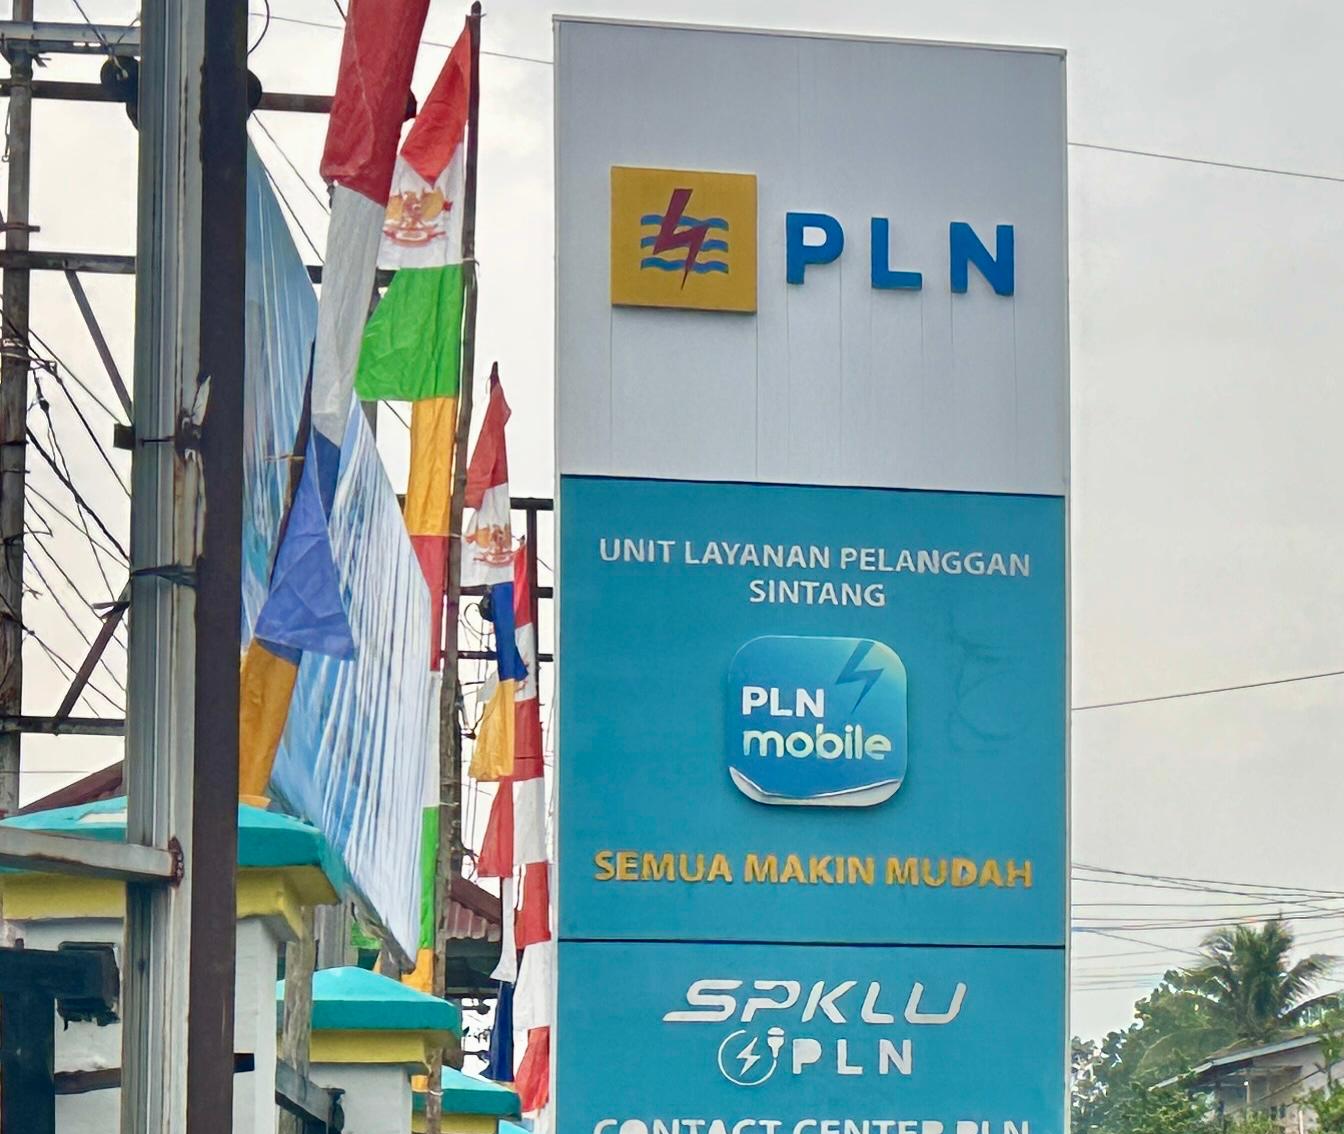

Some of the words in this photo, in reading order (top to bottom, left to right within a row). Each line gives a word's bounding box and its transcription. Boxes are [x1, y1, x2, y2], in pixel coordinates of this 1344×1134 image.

[785, 211, 1014, 297] PLN
[599, 538, 675, 564] UNIT
[684, 541, 831, 570] LAYANAN
[840, 546, 1031, 577] PELANGGAN
[749, 579, 887, 607] SINTANG
[741, 686, 825, 718] PLN
[743, 724, 892, 761] mobile
[593, 851, 733, 883] SEMUA
[744, 854, 875, 885] MAKIN
[885, 857, 1034, 888] MUDAH
[662, 979, 967, 1025] SPKLU
[793, 1038, 912, 1075] PLN
